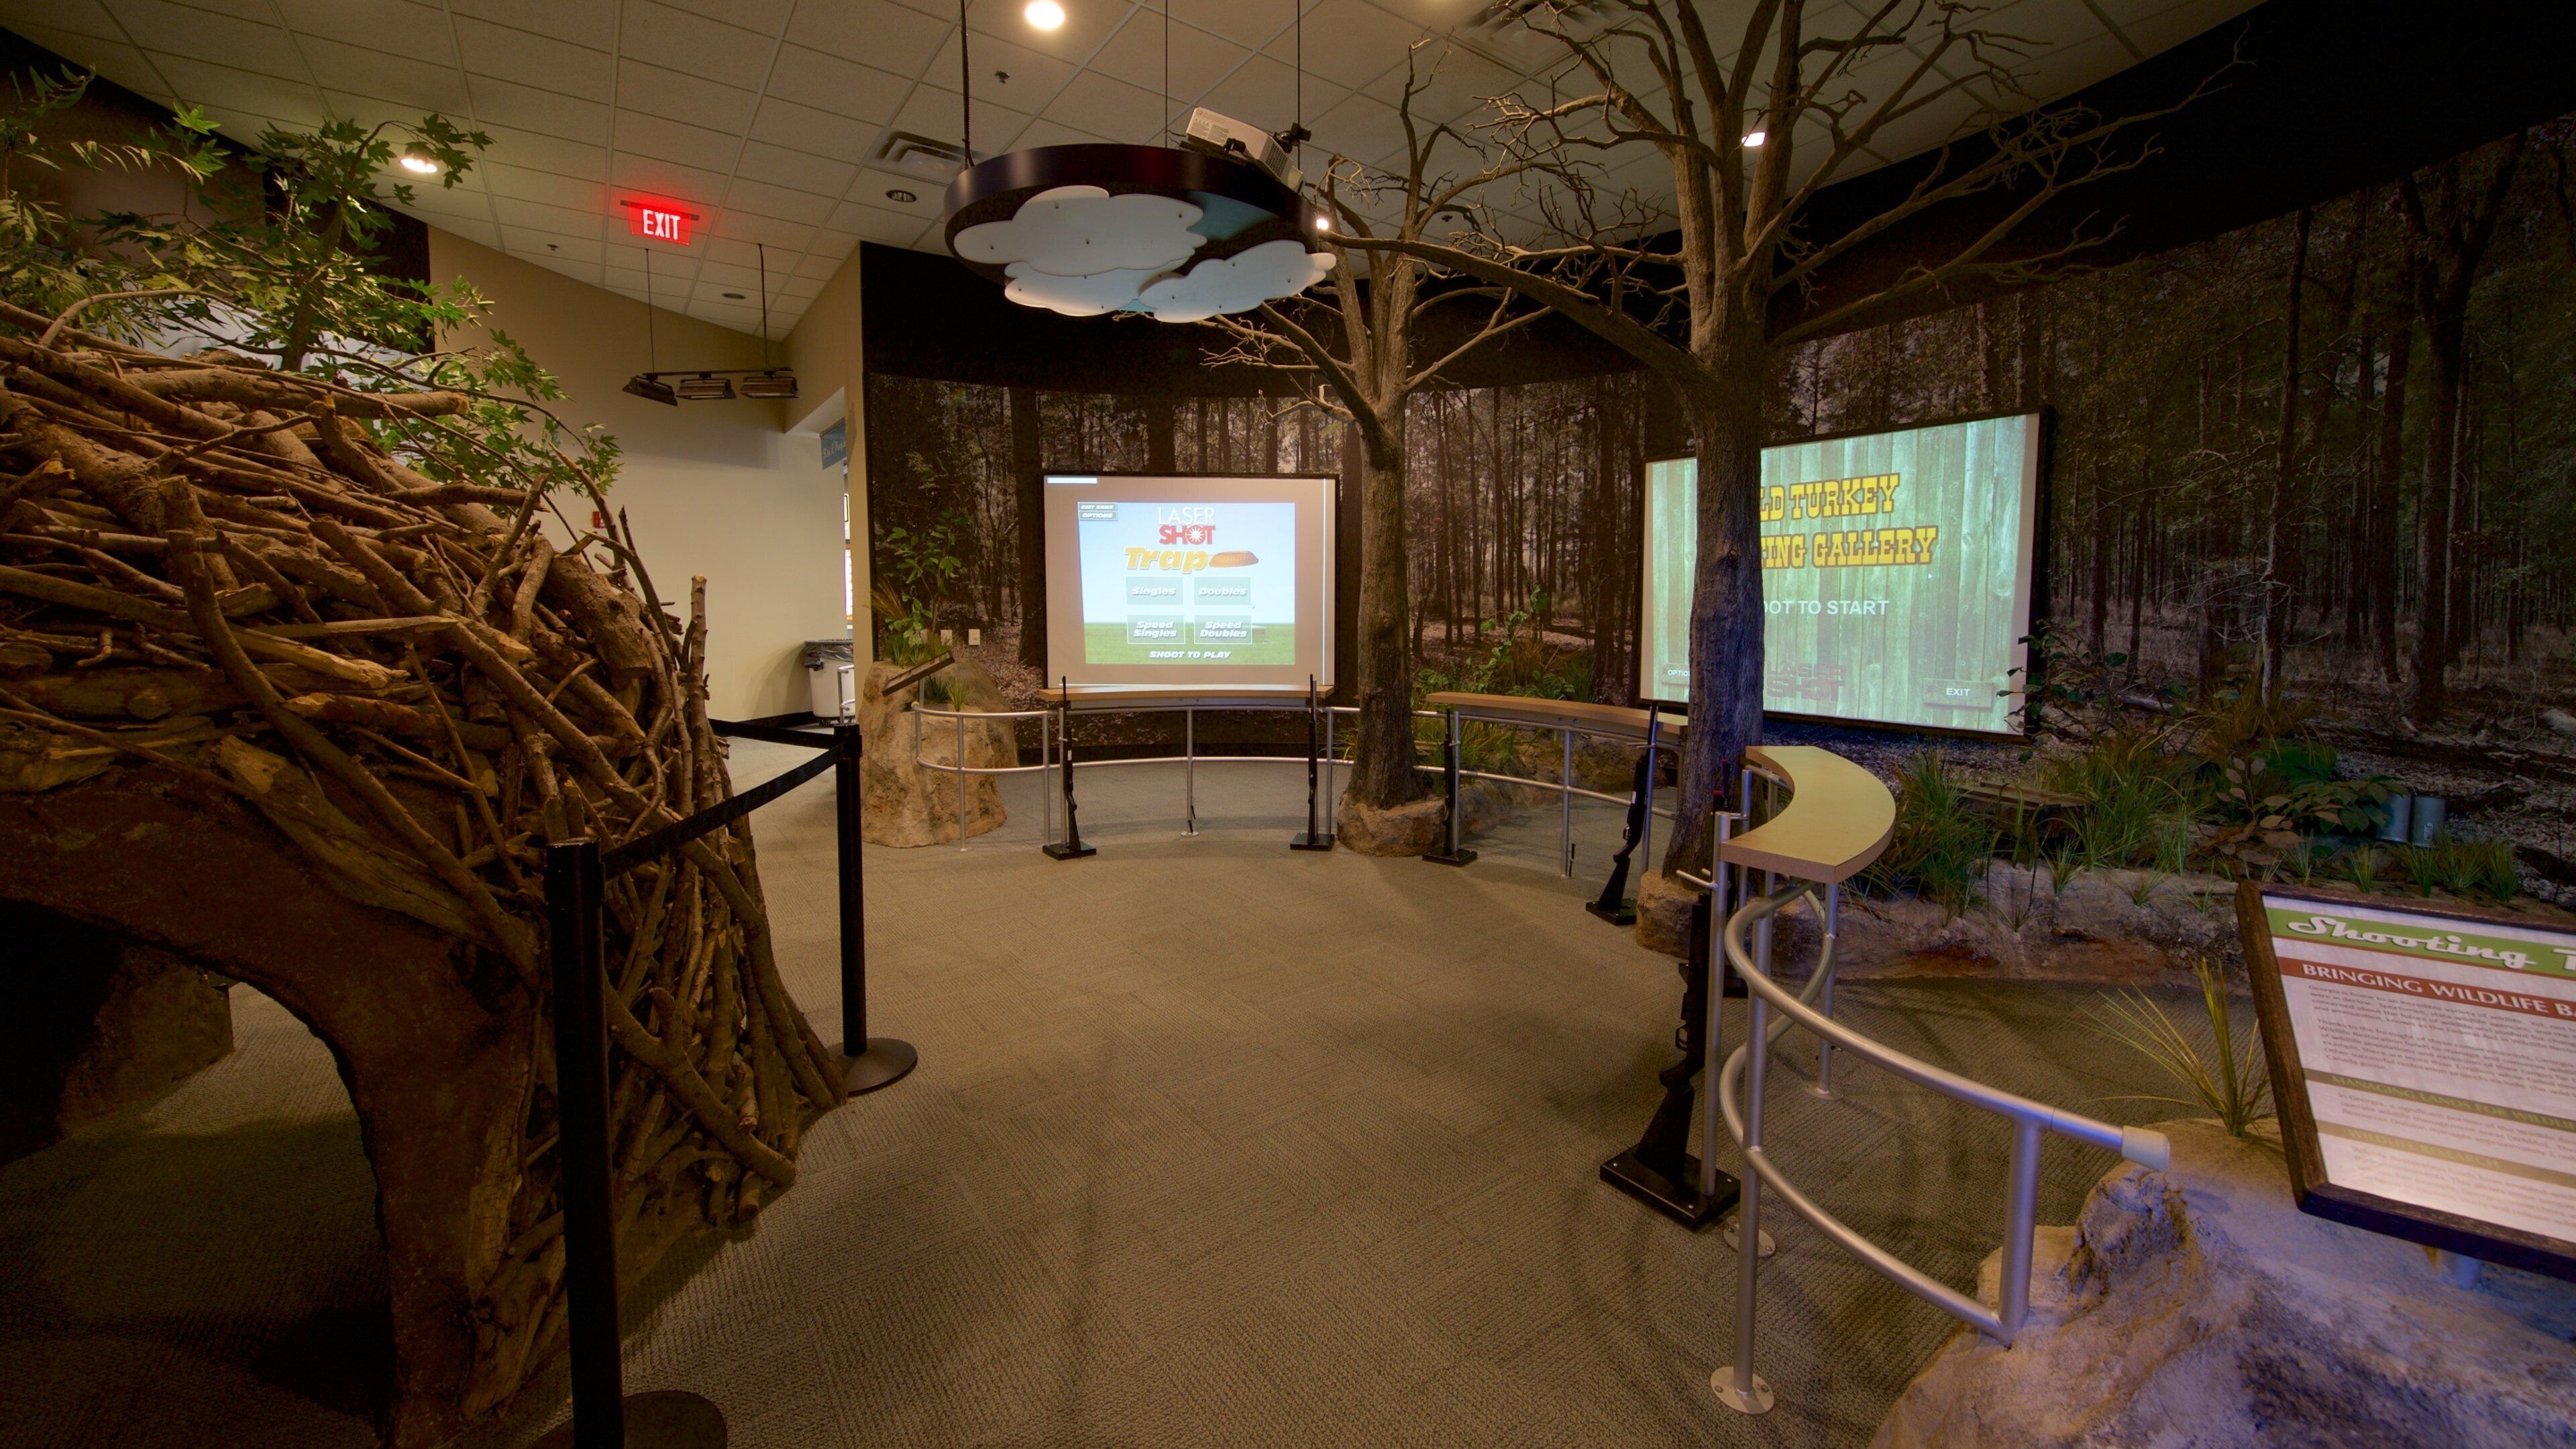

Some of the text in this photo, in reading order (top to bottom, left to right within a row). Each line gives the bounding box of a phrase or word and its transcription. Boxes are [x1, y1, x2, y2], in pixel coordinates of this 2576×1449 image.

[643, 209, 680, 240] EXIT
[1789, 472, 1900, 520] TURKEY
[1159, 507, 1216, 525] LASER
[1159, 525, 1216, 545] SHOT
[1813, 525, 1939, 568] GALLERY
[1124, 546, 1209, 574] Trap
[1131, 586, 1177, 597] Singles
[1199, 587, 1248, 596] Doubles
[1799, 600, 1821, 615] TO
[1827, 600, 1889, 615] START
[1133, 629, 1177, 639] Singles
[1136, 621, 1174, 631] Speed
[1199, 629, 1247, 638] Doubles
[1204, 621, 1242, 631] Speed
[1149, 651, 1185, 659] SHOOT
[1667, 669, 1690, 678] OPTIO
[1946, 687, 1971, 697] EXIT
[2288, 916, 2537, 970] Shooting
[2302, 963, 2424, 994] BRINGING
[2429, 982, 2549, 1014] WILDLIFE
[2308, 985, 2339, 995] Georgia
[2350, 991, 2373, 1000] home
[2401, 1000, 2441, 1010] incredible
[2445, 1007, 2474, 1016] variety
[2311, 998, 2354, 1009] concerned
[2400, 1012, 2426, 1021] future
[2441, 1019, 2473, 1029] wildlife
[2495, 1028, 2528, 1039] pushed
[2317, 1018, 2346, 1028] Thanks
[2376, 1028, 2414, 1040] foresight
[2428, 1037, 2451, 1046] these
[2455, 1015, 2485, 1024] wildlife
[2318, 1025, 2350, 1035] Wildlife
[2353, 1031, 2402, 1044] Restoration
[2404, 1040, 2429, 1049] funds
[2443, 1048, 2480, 1059] manage
[2502, 1059, 2544, 1069] conserve
[2386, 1017, 2415, 1026] known
[2446, 1027, 2479, 1037] Federal
[2511, 1038, 2546, 1049] Wildlife
[2325, 1054, 2357, 1065] Canada
[2331, 1034, 2361, 1044] wildlife
[2364, 1040, 2415, 1054] populations
[2436, 1053, 2481, 1065] extension
[2496, 1063, 2517, 1072] their
[2363, 1047, 2385, 1055] there
[2431, 1059, 2451, 1067] than
[2463, 1065, 2494, 1075] million
[2323, 1046, 2348, 1055] Other
[2351, 1051, 2394, 1064] successful
[2397, 1060, 2447, 1073] restoration
[2449, 1069, 2487, 1082] projects
[2550, 1088, 2569, 1096] wild
[2331, 1075, 2416, 1098] MANAGING
[2419, 1091, 2471, 1109] LANDS
[2475, 1103, 2507, 1116] FOR
